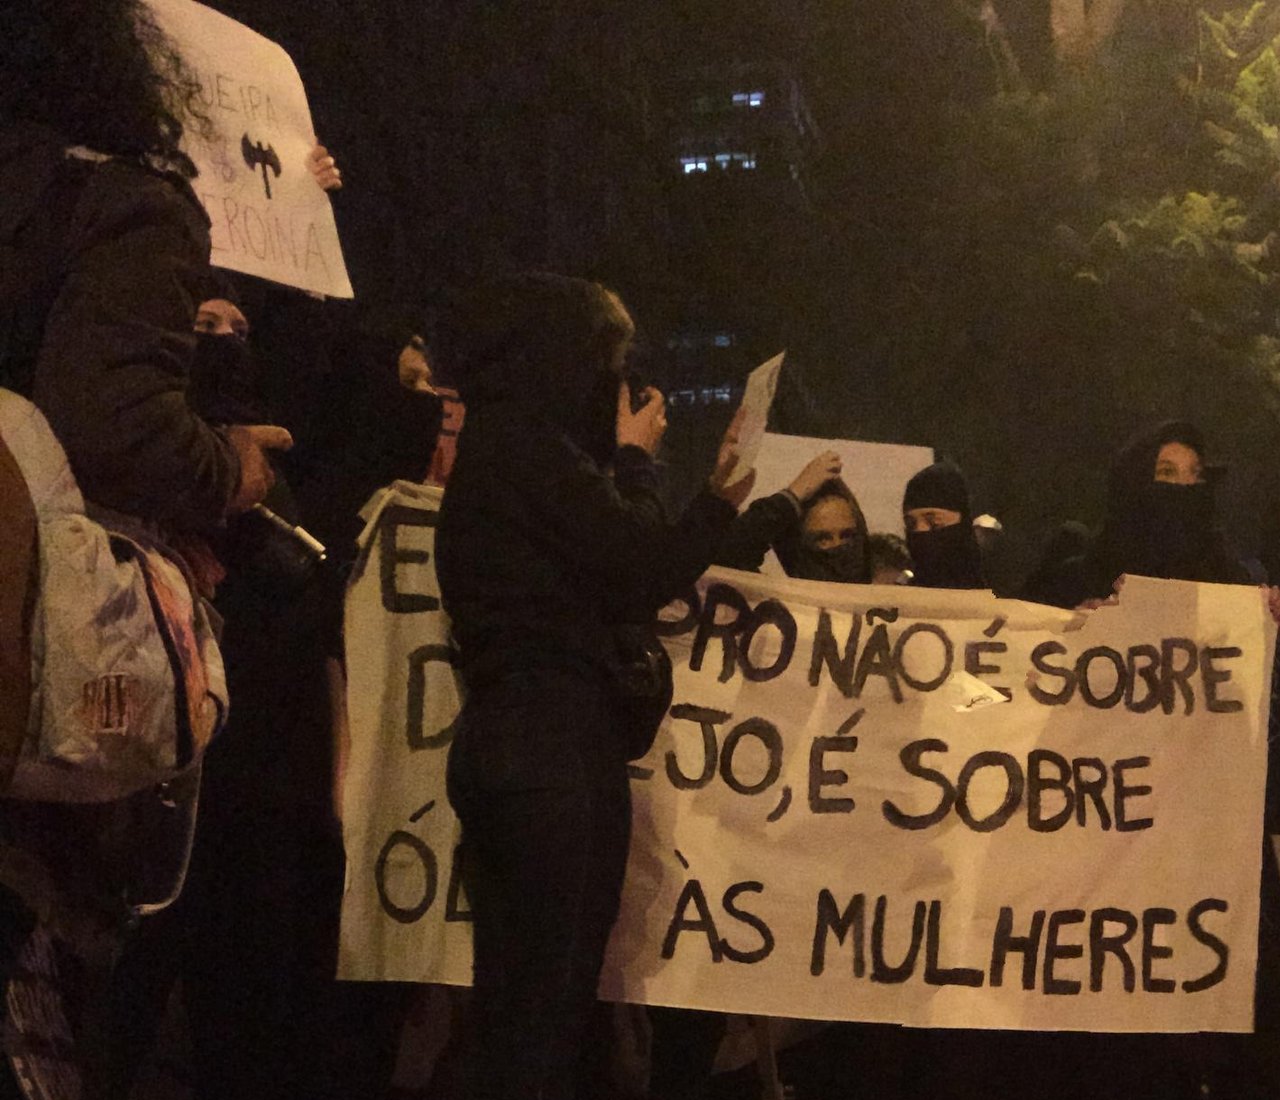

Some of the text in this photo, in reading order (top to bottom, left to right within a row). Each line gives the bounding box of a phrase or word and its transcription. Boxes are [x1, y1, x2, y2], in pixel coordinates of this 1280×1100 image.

[807, 606, 954, 704] NÃO
[964, 616, 1013, 703] É
[1025, 637, 1244, 715] SOBRE
[808, 708, 866, 814] É
[881, 737, 1153, 832] SOBRE
[661, 848, 774, 963] ÀS
[809, 886, 1229, 996] MULHERES
